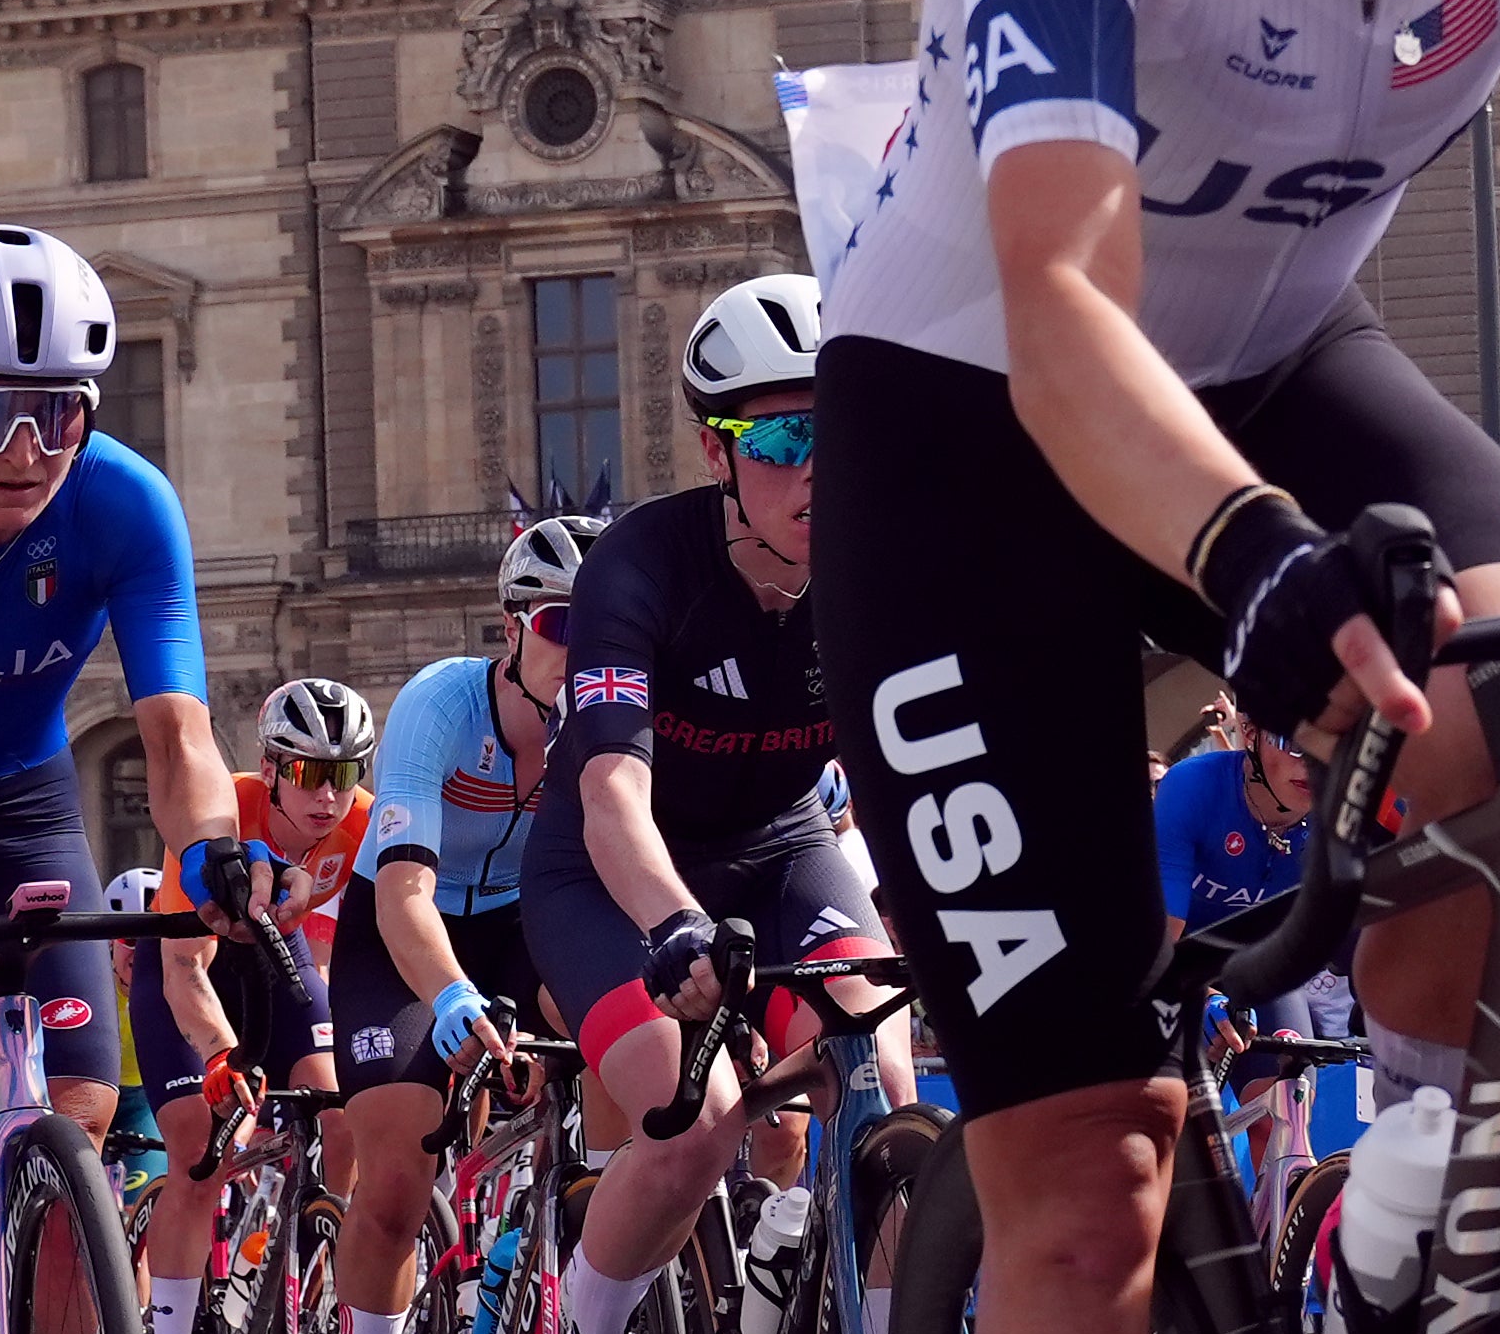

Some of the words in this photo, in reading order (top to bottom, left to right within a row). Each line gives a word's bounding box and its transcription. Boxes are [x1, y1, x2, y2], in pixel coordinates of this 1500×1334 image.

[1226, 54, 1317, 90] CUORE
[653, 711, 755, 755] GREAT
[872, 653, 1068, 1017] USA
[25, 892, 65, 904] wahoo
[689, 1005, 731, 1083] SRAM
[462, 1050, 493, 1103] SRAM
[1273, 1204, 1305, 1293] RESERVE
